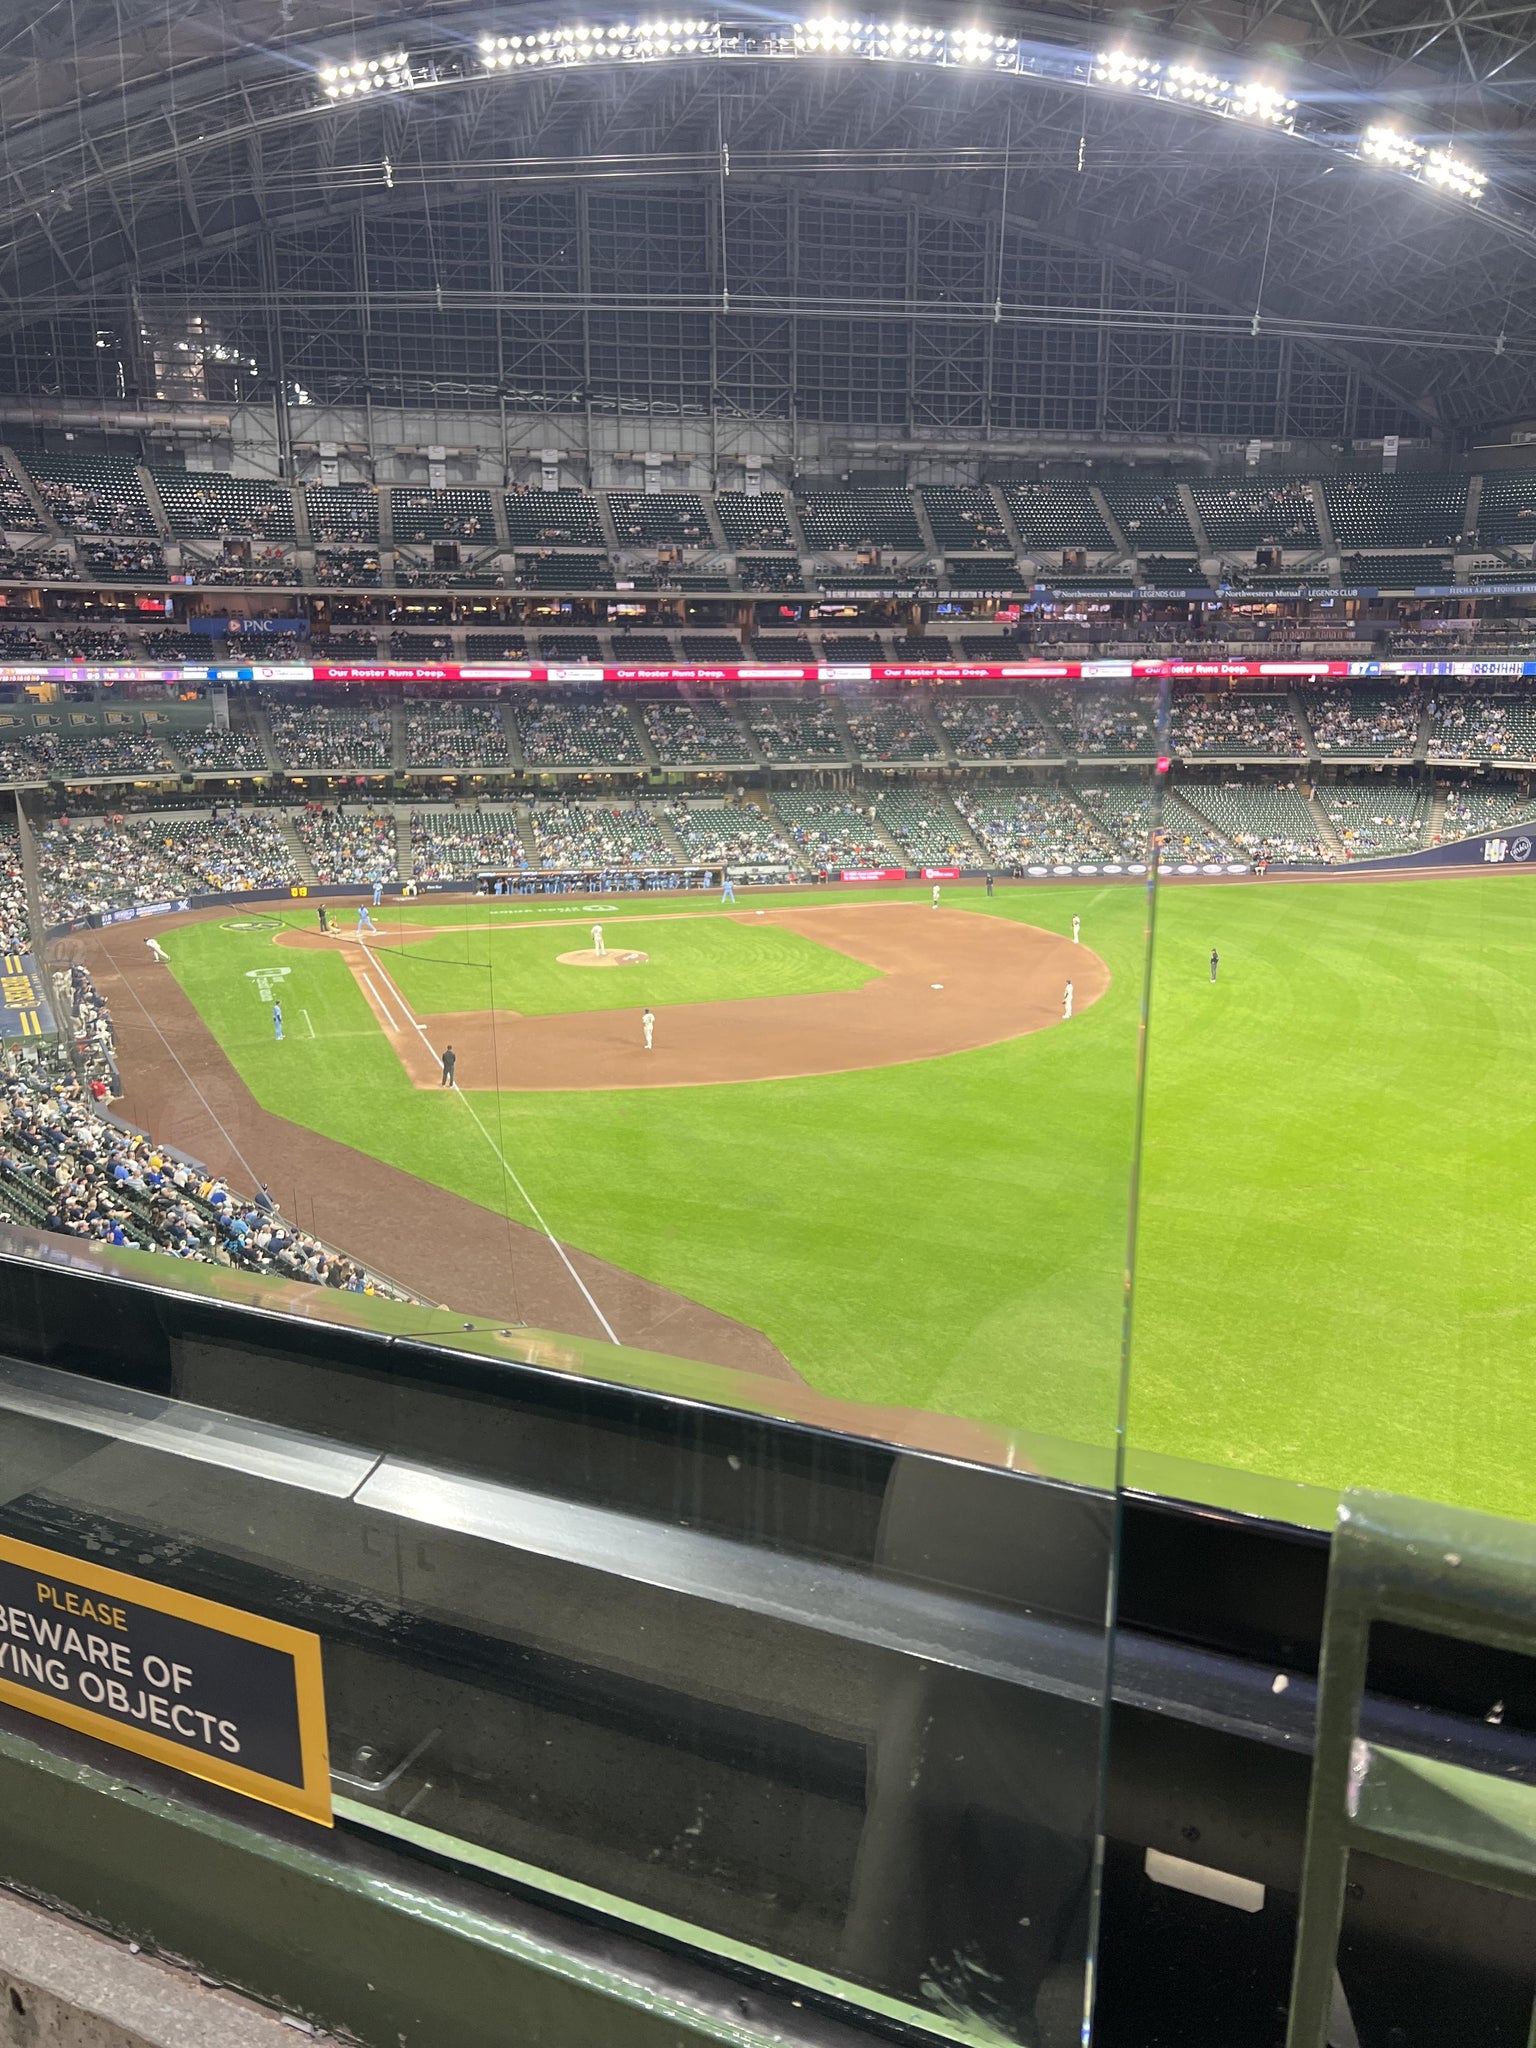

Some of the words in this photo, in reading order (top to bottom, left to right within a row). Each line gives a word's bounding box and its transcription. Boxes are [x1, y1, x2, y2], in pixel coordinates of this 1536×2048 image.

[1061, 590, 1108, 598] Northwestern
[1108, 590, 1134, 598] Mutual
[1139, 590, 1168, 598] LEGENDS
[1168, 590, 1186, 598] CLUB
[1224, 590, 1274, 598] Northwestern
[1274, 590, 1301, 598] Mutual
[1307, 589, 1339, 597] LEGENDS
[1339, 589, 1358, 597] CLUB
[243, 620, 274, 632] PNC
[328, 669, 348, 677] Our
[351, 669, 385, 677] Roster
[388, 669, 414, 677] Runs
[416, 669, 446, 678] Deep.
[962, 669, 989, 677] Deep.
[1196, 664, 1218, 674] Runs
[1221, 664, 1249, 674] Deep.
[698, 670, 725, 678] Deep.
[37, 1582, 128, 1632] PLEASE
[0, 1604, 133, 1678] BEWARE
[142, 1655, 193, 1694] OF
[78, 1671, 241, 1753] OBJECTS
